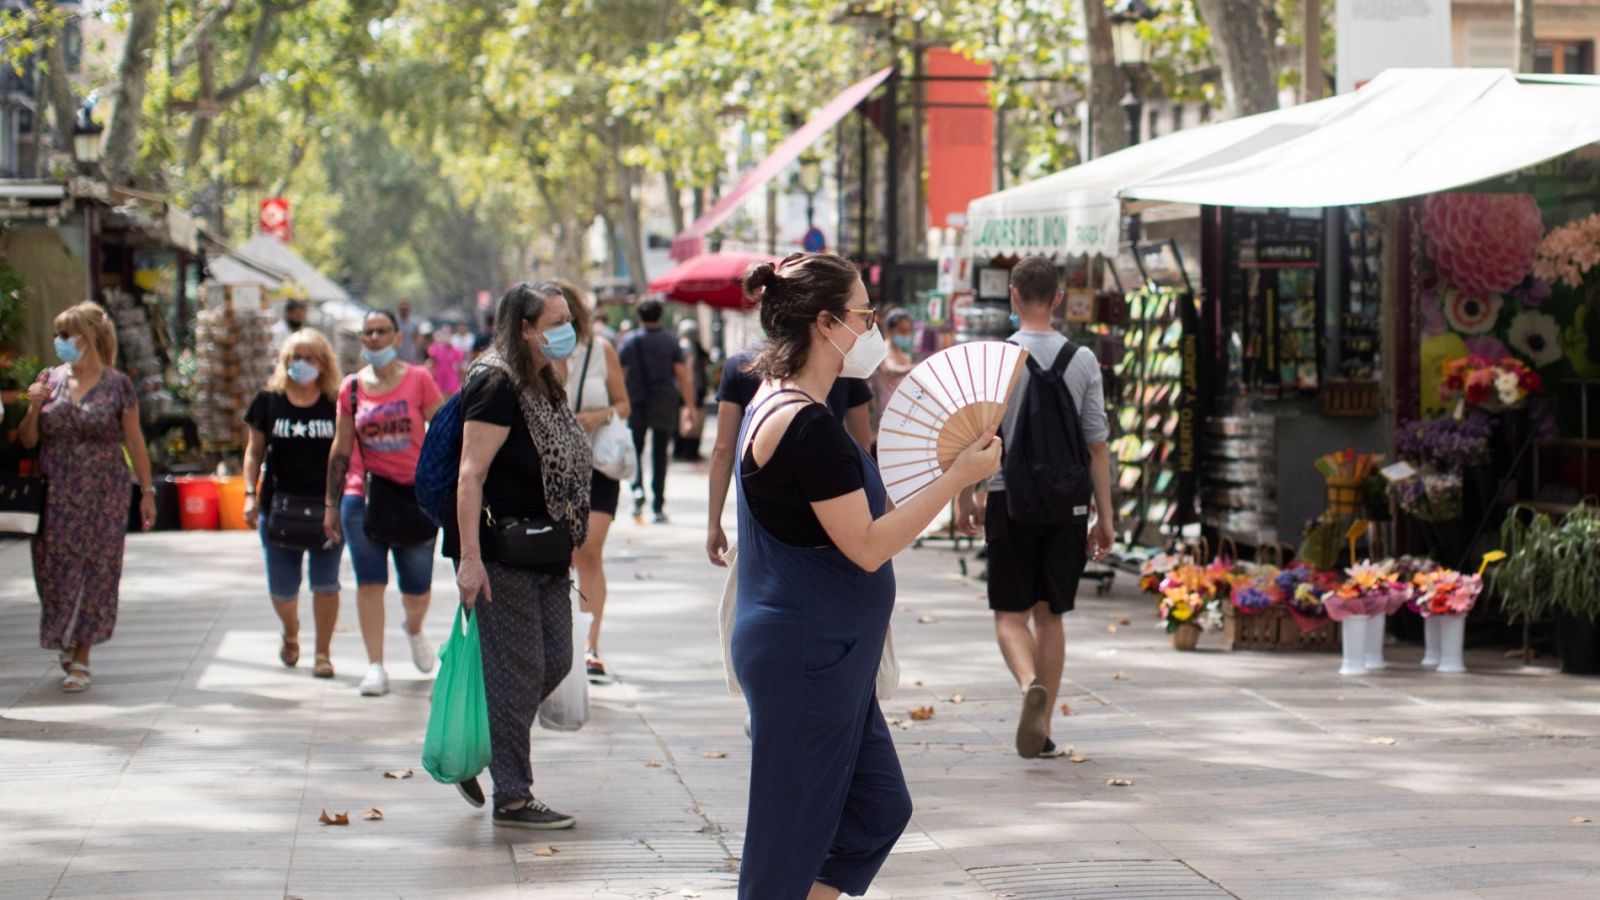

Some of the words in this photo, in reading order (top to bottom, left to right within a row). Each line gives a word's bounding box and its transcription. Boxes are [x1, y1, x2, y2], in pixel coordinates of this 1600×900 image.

[1018, 217, 1039, 247] DEL
[272, 418, 291, 438] ALL
[308, 419, 335, 438] STAR
